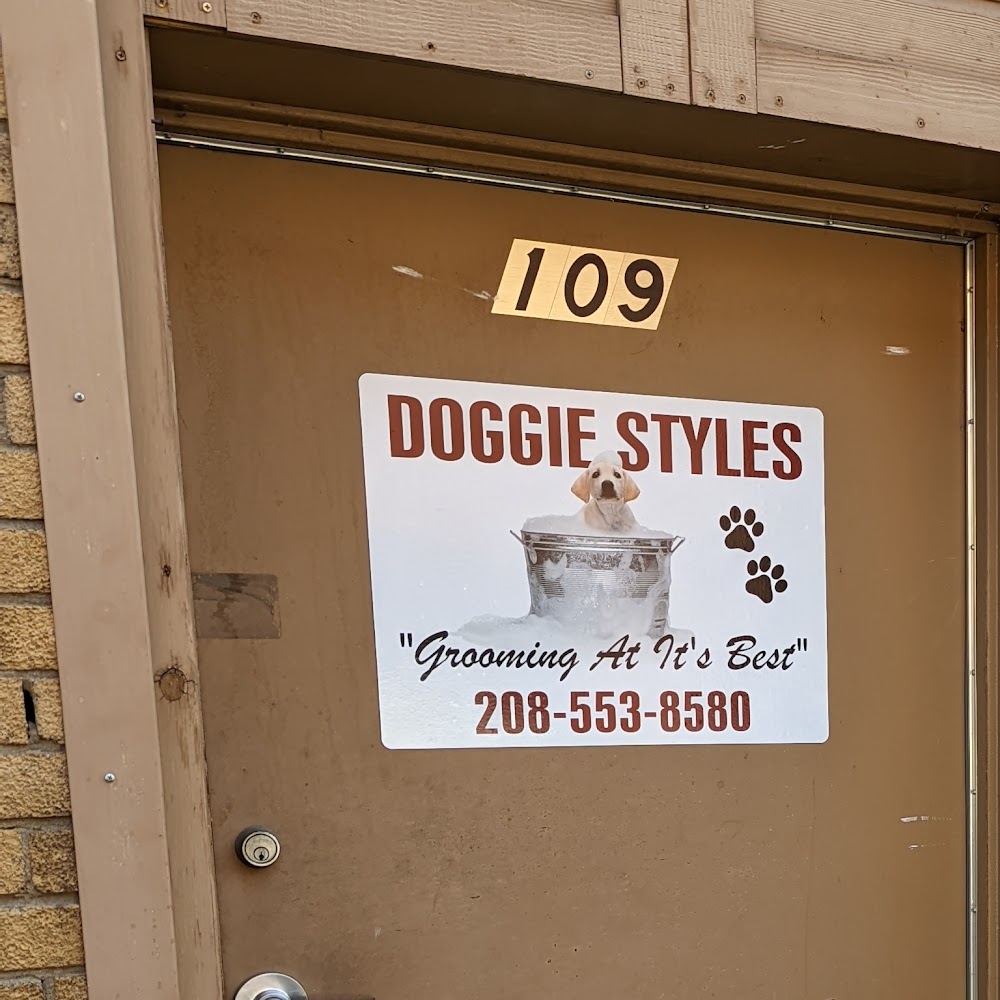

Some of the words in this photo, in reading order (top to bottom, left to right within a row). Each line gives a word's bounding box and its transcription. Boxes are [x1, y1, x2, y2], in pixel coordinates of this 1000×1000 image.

[515, 247, 665, 323] 109
[387, 394, 597, 469] DOGGIE
[616, 411, 803, 480] STYLES
[400, 631, 580, 682] "Grooming
[590, 634, 641, 671] At
[653, 635, 713, 670] It's
[726, 635, 808, 672] Best"
[474, 690, 751, 735] 208-553-8580
